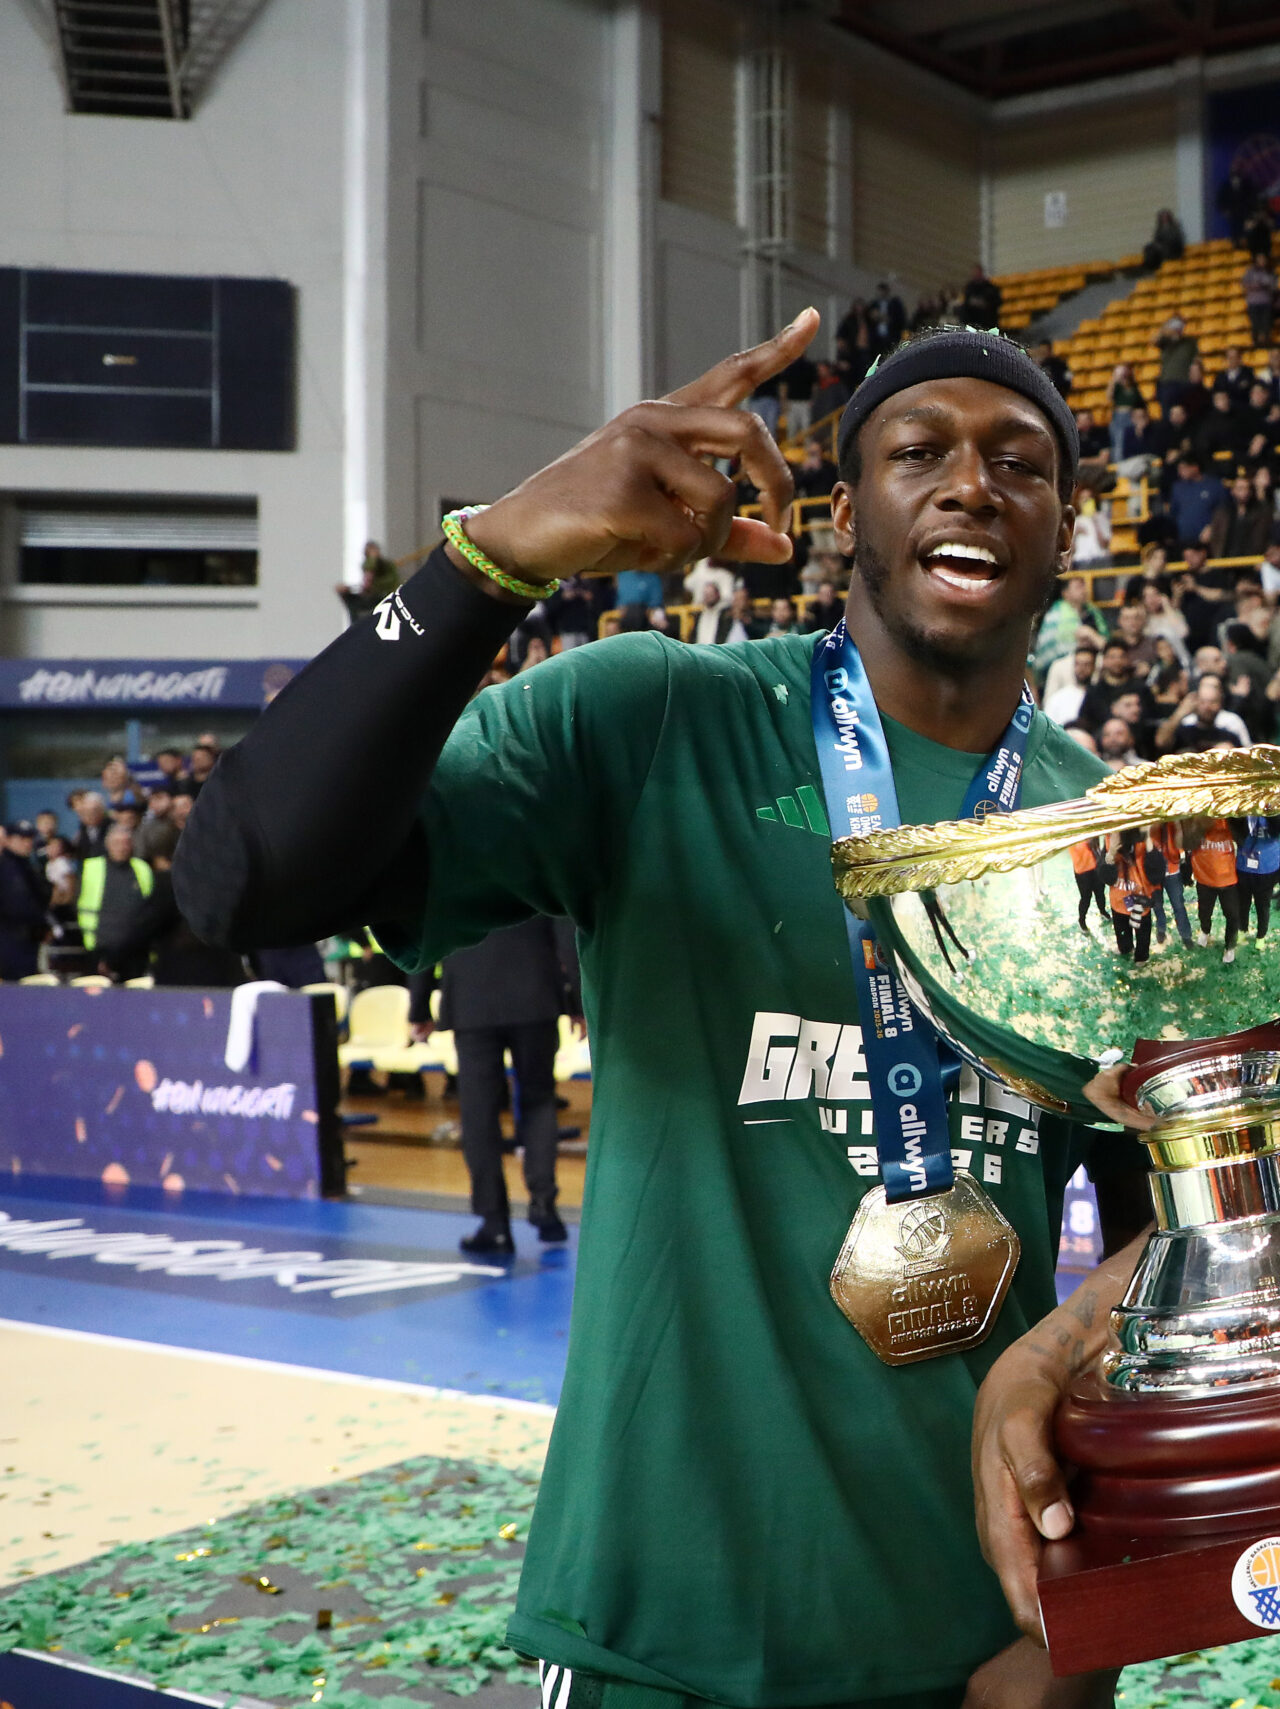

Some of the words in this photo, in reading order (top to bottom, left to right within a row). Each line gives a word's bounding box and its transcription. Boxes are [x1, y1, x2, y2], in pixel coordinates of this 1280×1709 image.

[832, 697, 864, 772] allwyn
[986, 747, 1011, 793] allwyn
[998, 763, 1020, 806] FINAL
[1011, 751, 1022, 764] 8
[877, 974, 897, 1025] FINAL
[884, 1026, 898, 1039] 8
[818, 1106, 1040, 1155] WIERS
[899, 1103, 928, 1192] allwyn
[892, 1272, 970, 1303] allwyn
[887, 1301, 959, 1335] FINAL
